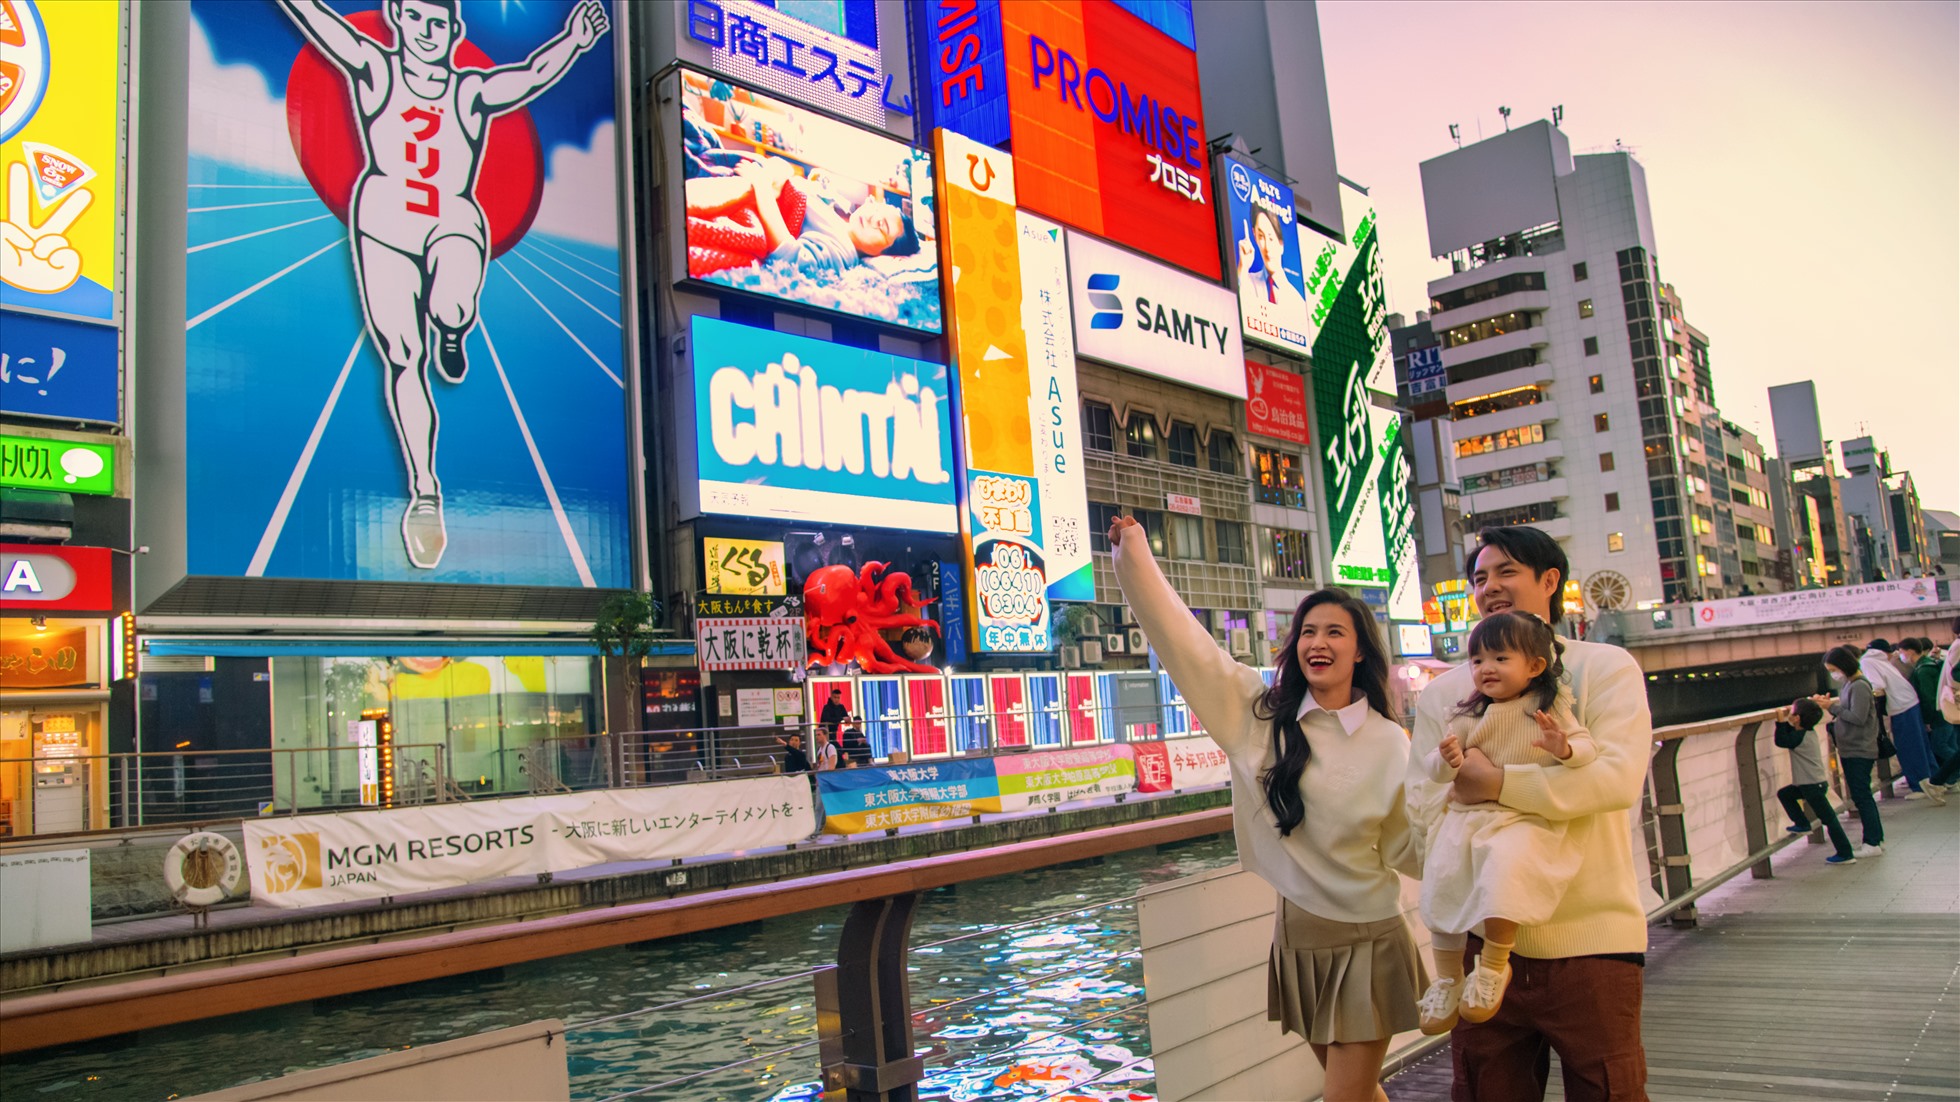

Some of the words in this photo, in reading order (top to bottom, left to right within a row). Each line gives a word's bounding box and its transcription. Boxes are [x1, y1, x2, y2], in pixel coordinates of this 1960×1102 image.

[689, 0, 913, 117] 日商エステム
[1030, 34, 1202, 170] PROMISE
[42, 153, 78, 174] SNOW
[401, 106, 444, 218] グリコ
[1146, 154, 1206, 205] プロミス
[1023, 224, 1048, 244] Asue
[1135, 296, 1229, 356] SAMTY
[1047, 375, 1066, 474] Asue
[1327, 360, 1373, 513] エイブル
[977, 478, 1029, 505] ひまわり
[997, 547, 1022, 570] 06
[2, 559, 43, 593] A
[697, 599, 774, 615] 大阪もんを食す
[990, 593, 1036, 615] 6304
[704, 625, 792, 662] 大阪に乾杯
[988, 630, 1046, 647] 年中無休
[886, 765, 939, 782] 東大阪大学
[327, 842, 398, 870] MGM
[407, 824, 535, 861] RESORTS
[330, 870, 377, 887] JAPAN
